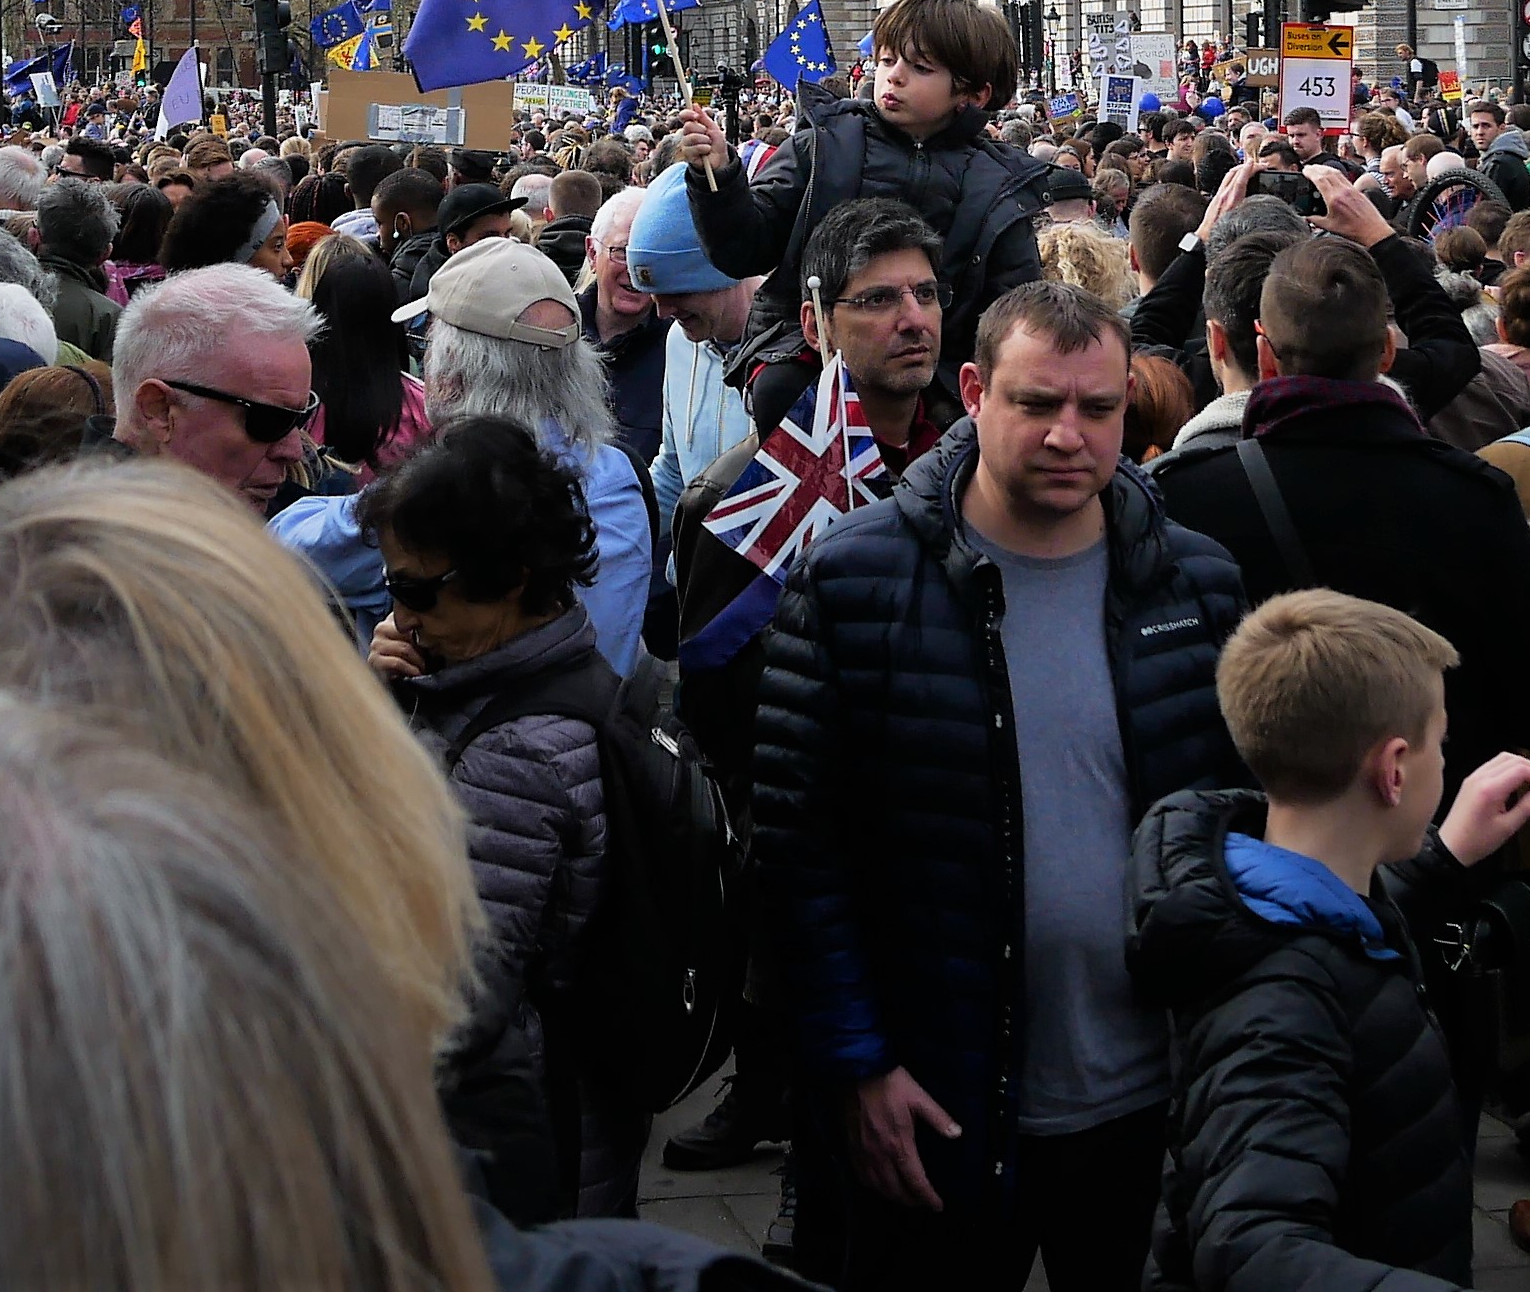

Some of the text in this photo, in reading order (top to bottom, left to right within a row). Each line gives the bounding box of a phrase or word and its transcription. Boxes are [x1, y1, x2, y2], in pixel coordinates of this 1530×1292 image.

[1086, 13, 1115, 26] BRITISH
[1094, 24, 1115, 34] TITS
[1287, 31, 1310, 40] Buses
[1287, 42, 1323, 52] Diversion
[1247, 56, 1279, 76] UGH
[515, 84, 547, 96] PEOPLE
[1298, 76, 1336, 97] 453
[550, 88, 588, 100] STRONGER
[550, 98, 588, 109] TOGETHER
